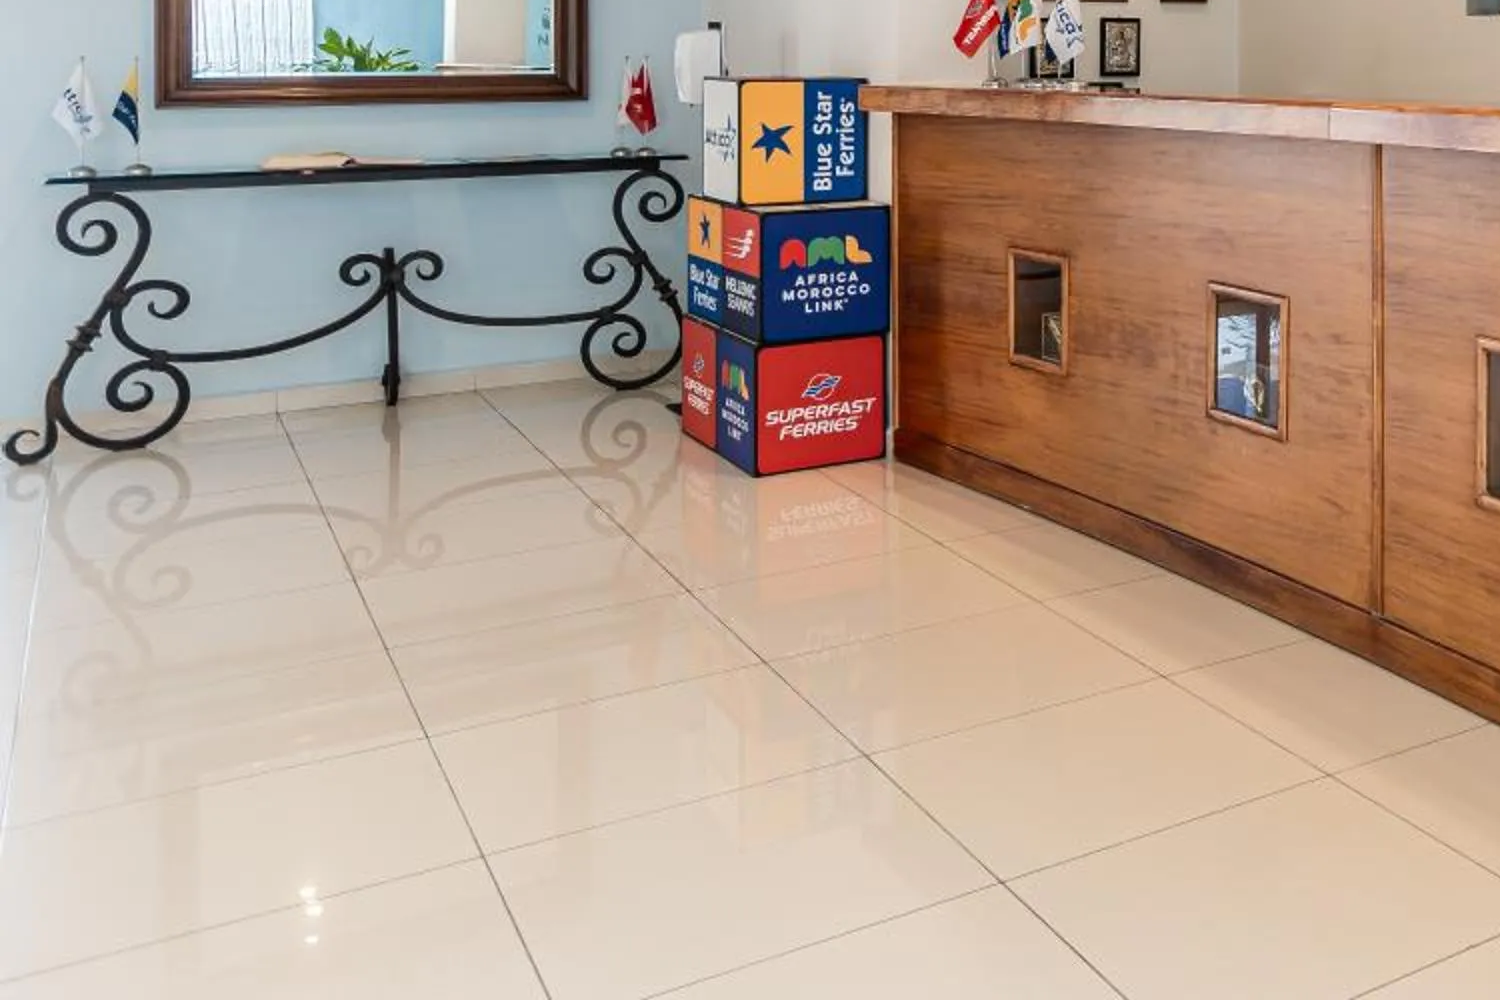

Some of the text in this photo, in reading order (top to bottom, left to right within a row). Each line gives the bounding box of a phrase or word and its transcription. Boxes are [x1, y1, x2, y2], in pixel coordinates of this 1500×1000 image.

[812, 91, 833, 192] Blue Star
[835, 101, 855, 177] Ferries
[795, 271, 859, 287] AFRICA
[782, 283, 871, 301] MOROCCO
[805, 299, 844, 313] LINK
[765, 397, 877, 427] SUPERFAST
[779, 416, 859, 441] FERRIES
